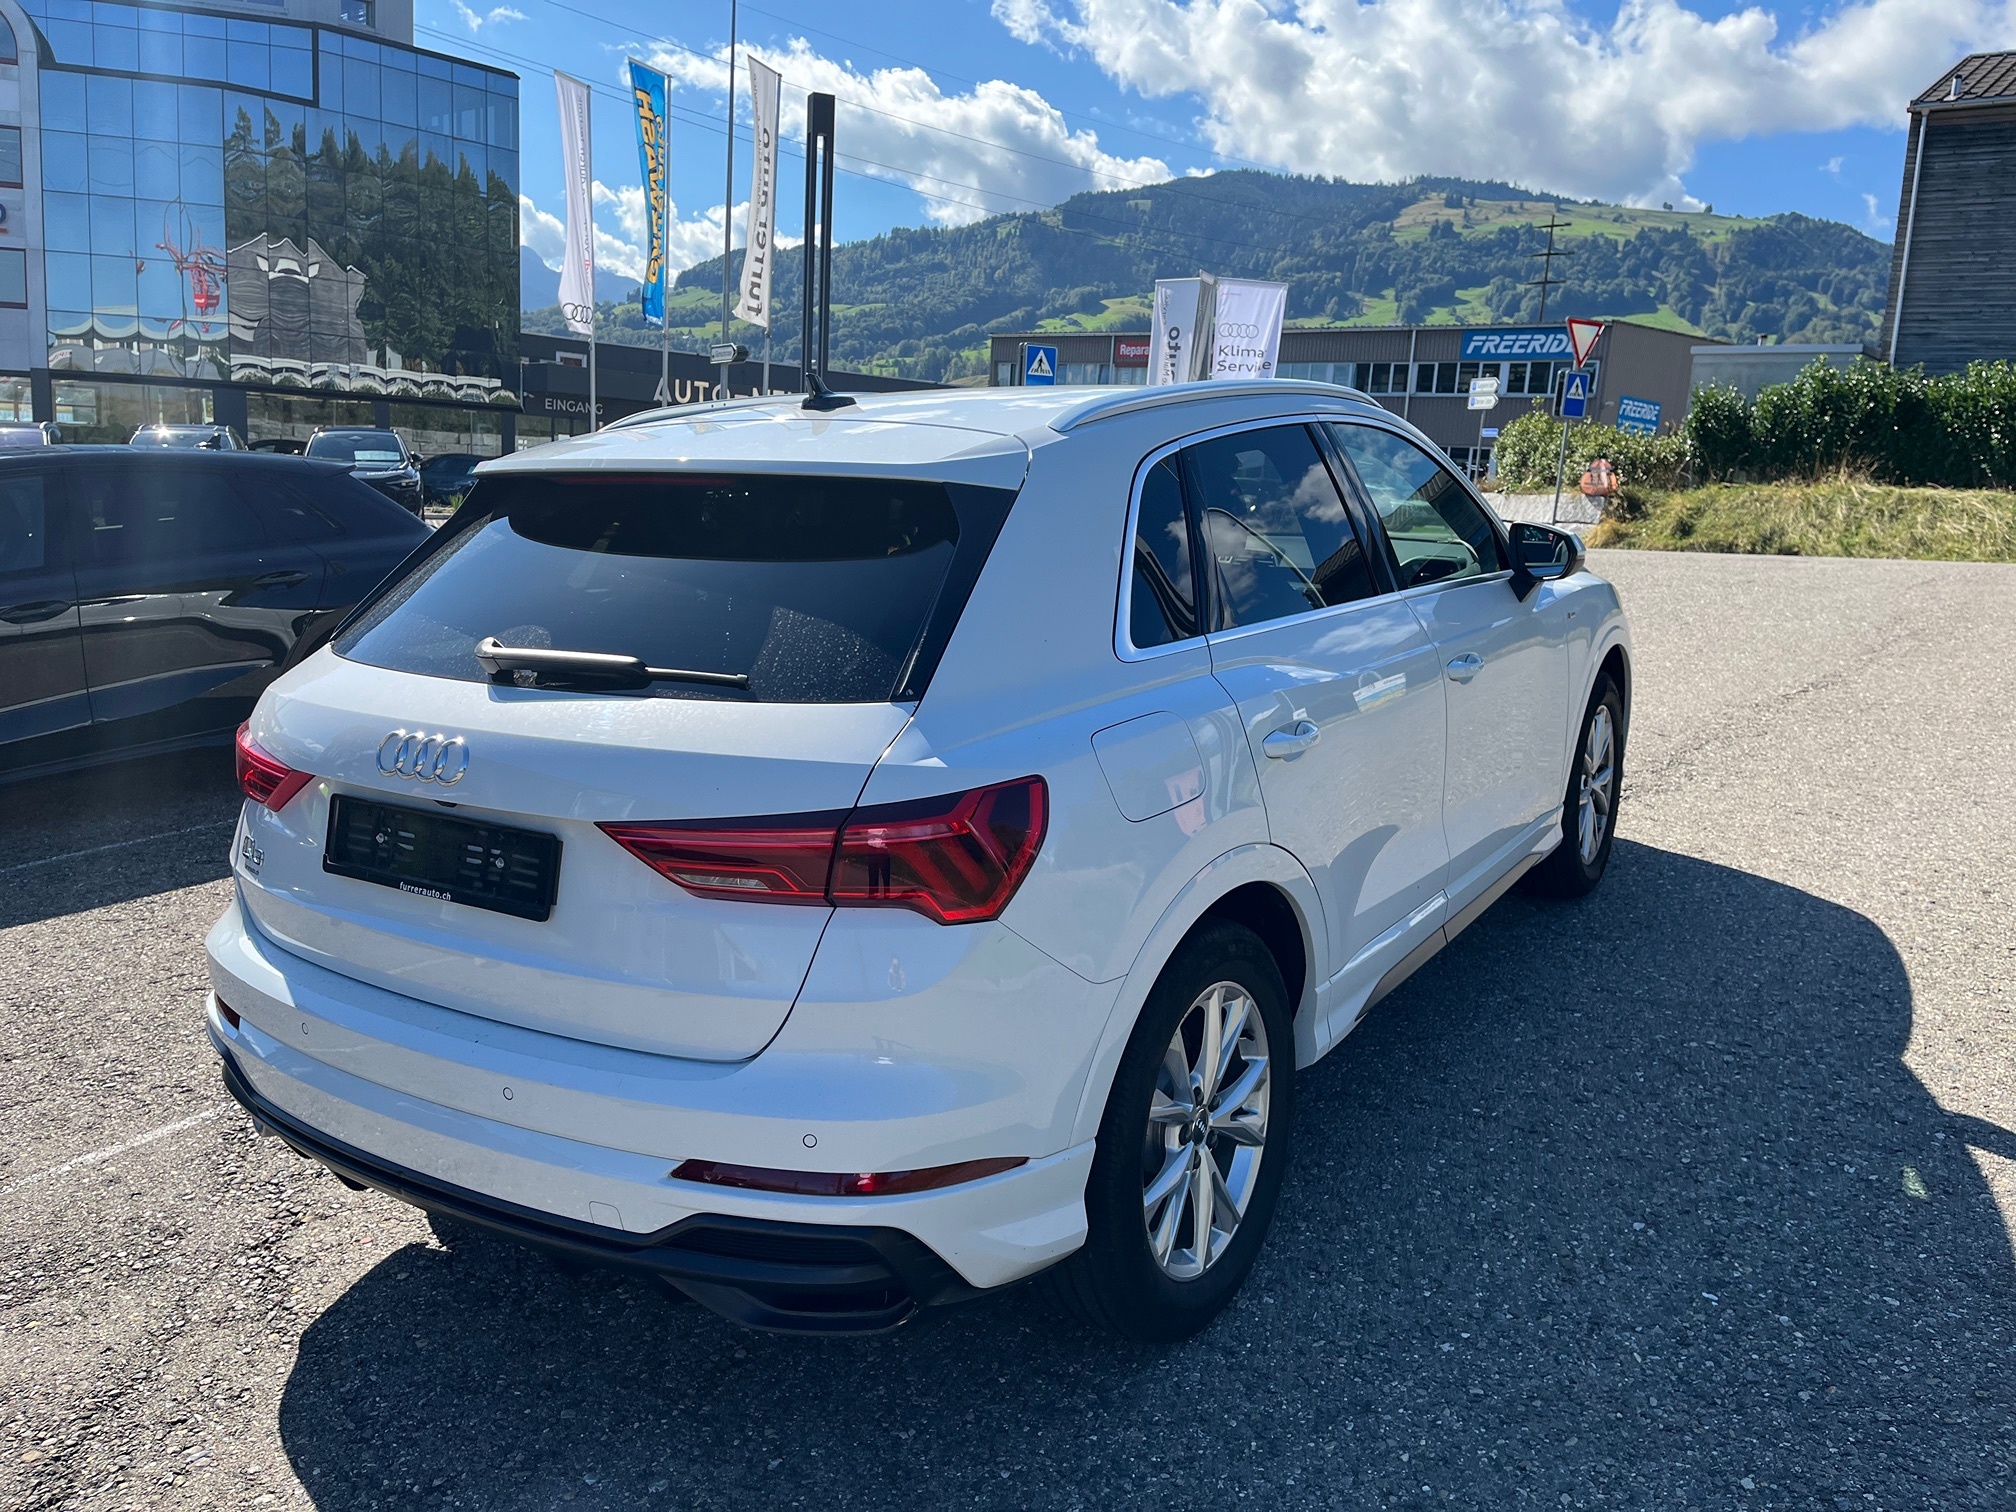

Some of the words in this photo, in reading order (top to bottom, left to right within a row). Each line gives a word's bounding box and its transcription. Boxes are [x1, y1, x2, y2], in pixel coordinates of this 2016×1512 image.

[545, 398, 604, 415] EINGANG
[1619, 399, 1660, 421] FREERIDE
[399, 881, 451, 901] furrerauto.ch
